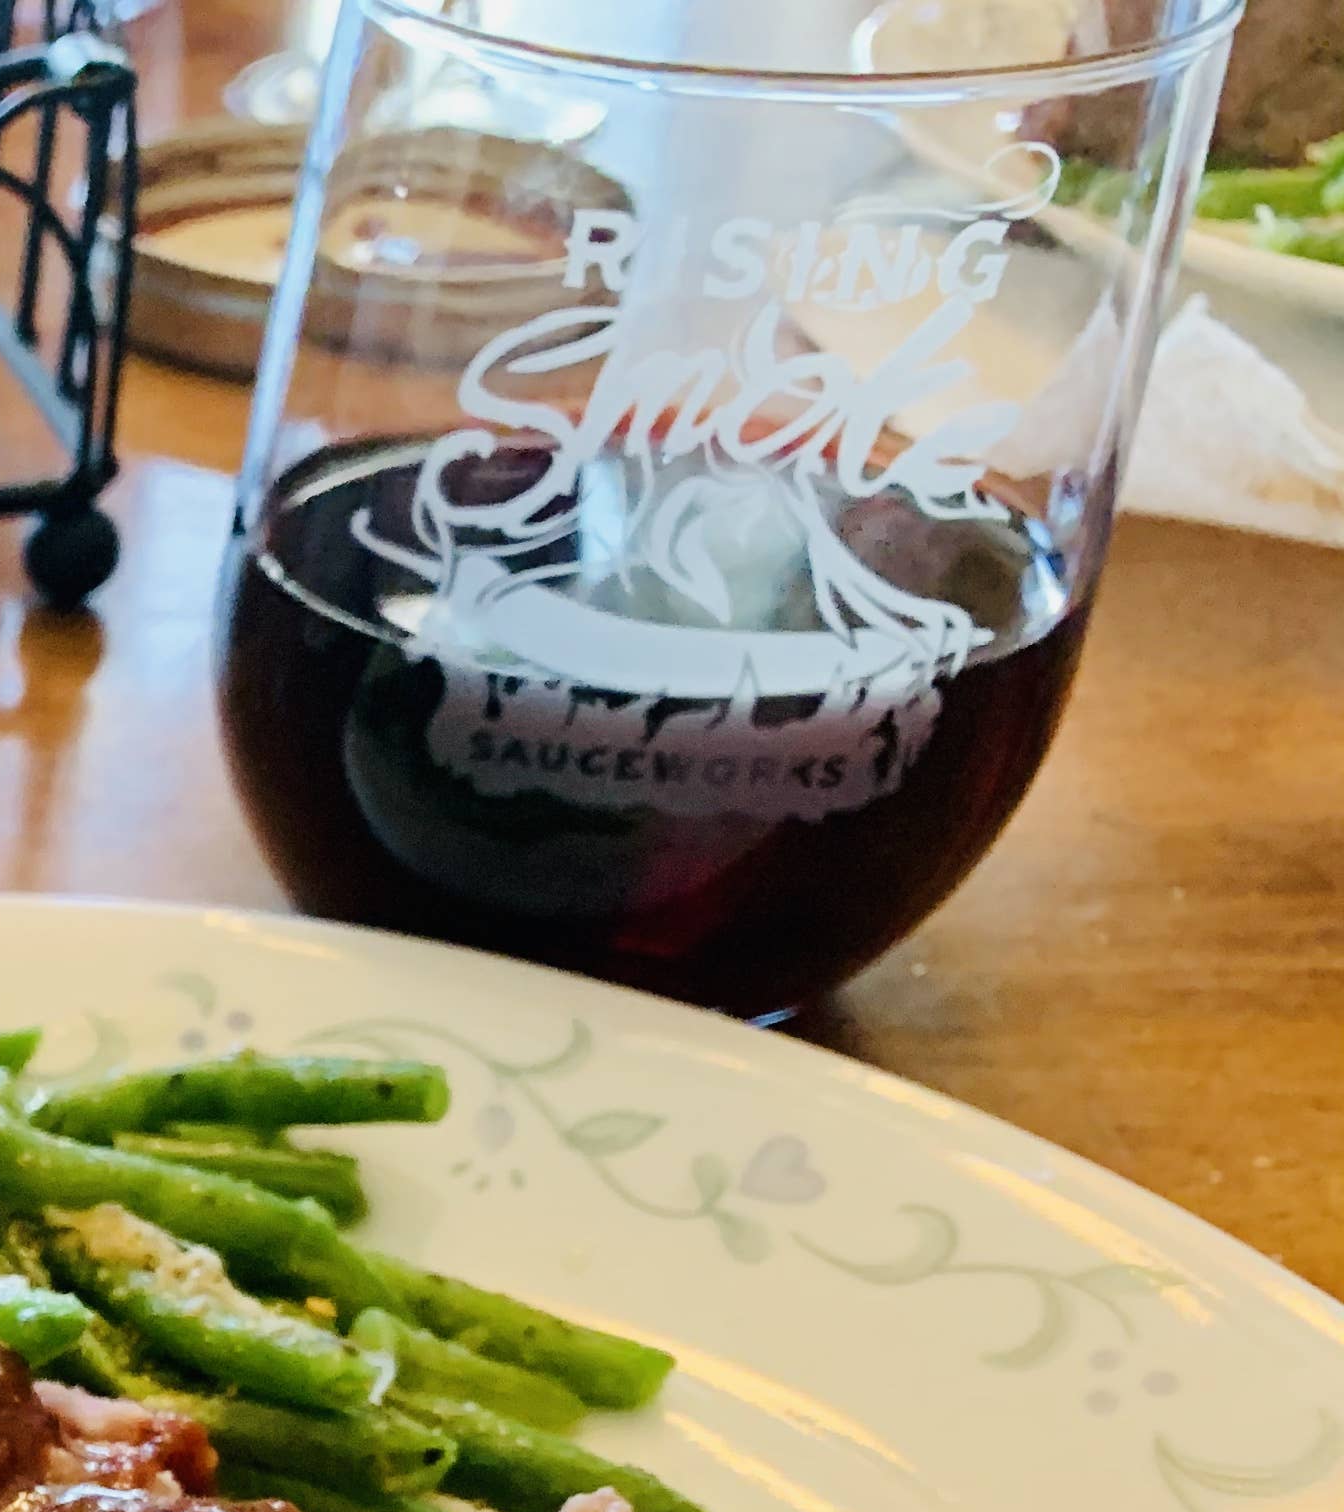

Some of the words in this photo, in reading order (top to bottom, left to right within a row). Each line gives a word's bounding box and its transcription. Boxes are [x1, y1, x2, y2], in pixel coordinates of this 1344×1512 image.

[562, 208, 1012, 298] RISING
[418, 302, 1016, 528] Smoke
[466, 726, 847, 791] SAUCEWORKS
